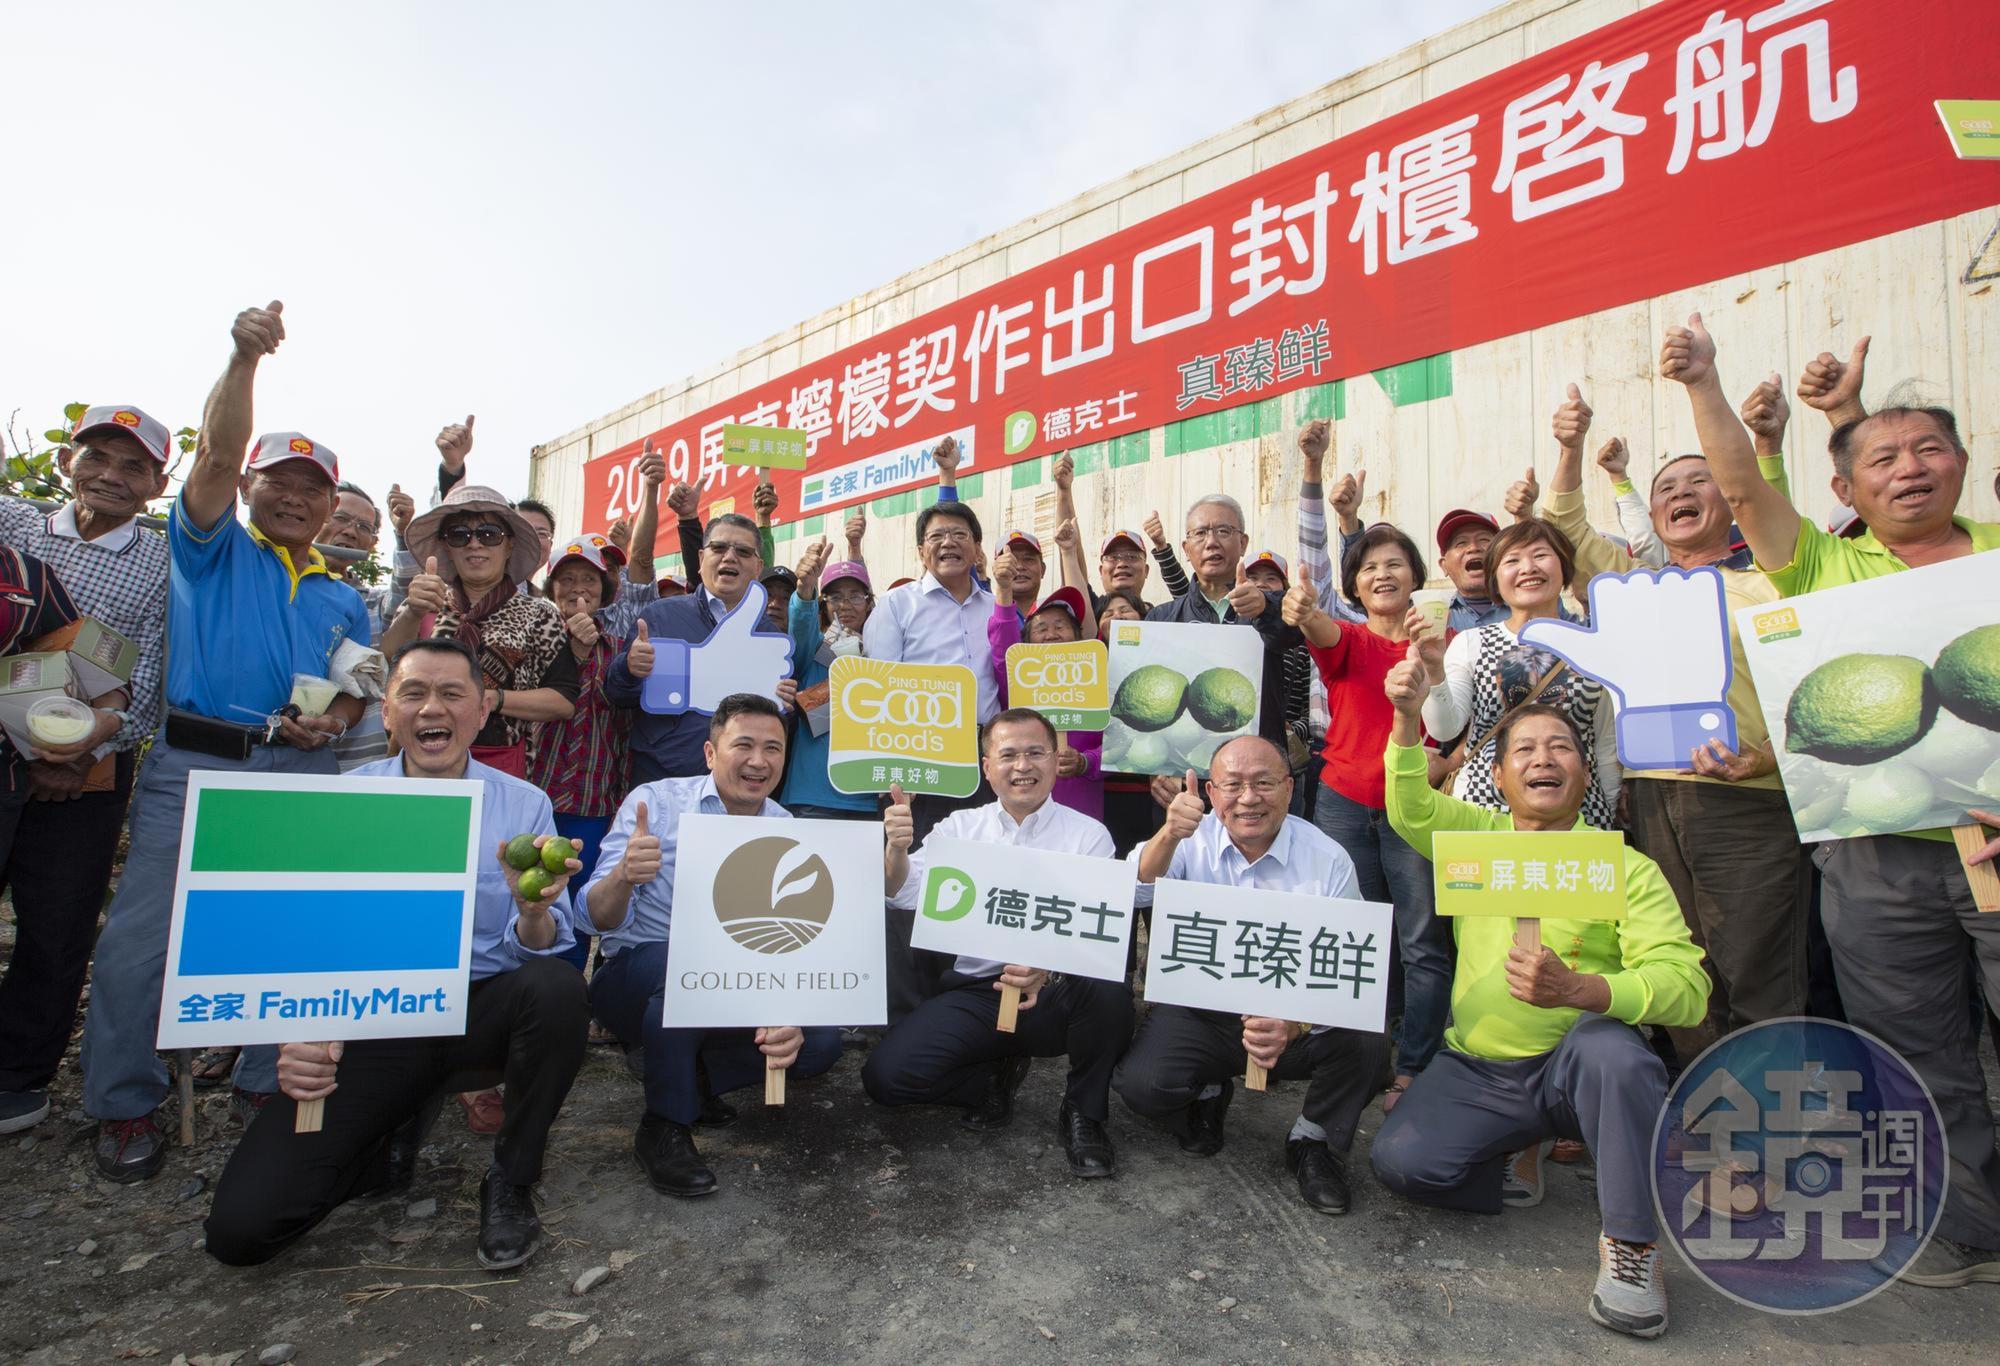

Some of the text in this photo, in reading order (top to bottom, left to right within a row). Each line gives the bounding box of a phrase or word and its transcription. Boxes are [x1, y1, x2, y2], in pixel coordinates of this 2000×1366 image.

[1042, 390, 1138, 442] 德克士
[748, 438, 803, 457] 屏東好物
[828, 439, 966, 498] 全家 FamilyMt
[1044, 652, 1093, 661] PING TUNG
[888, 677, 955, 692] PING TUNG
[842, 677, 962, 729] Good
[1043, 714, 1083, 725] 東好物
[866, 727, 945, 752] food's
[872, 766, 940, 784] 屏東好物
[1490, 859, 1616, 893] 屏東好物
[983, 886, 1126, 944] 德克士
[680, 971, 786, 991] GOLDEN
[177, 986, 447, 1023] 全家 FamilyMart
